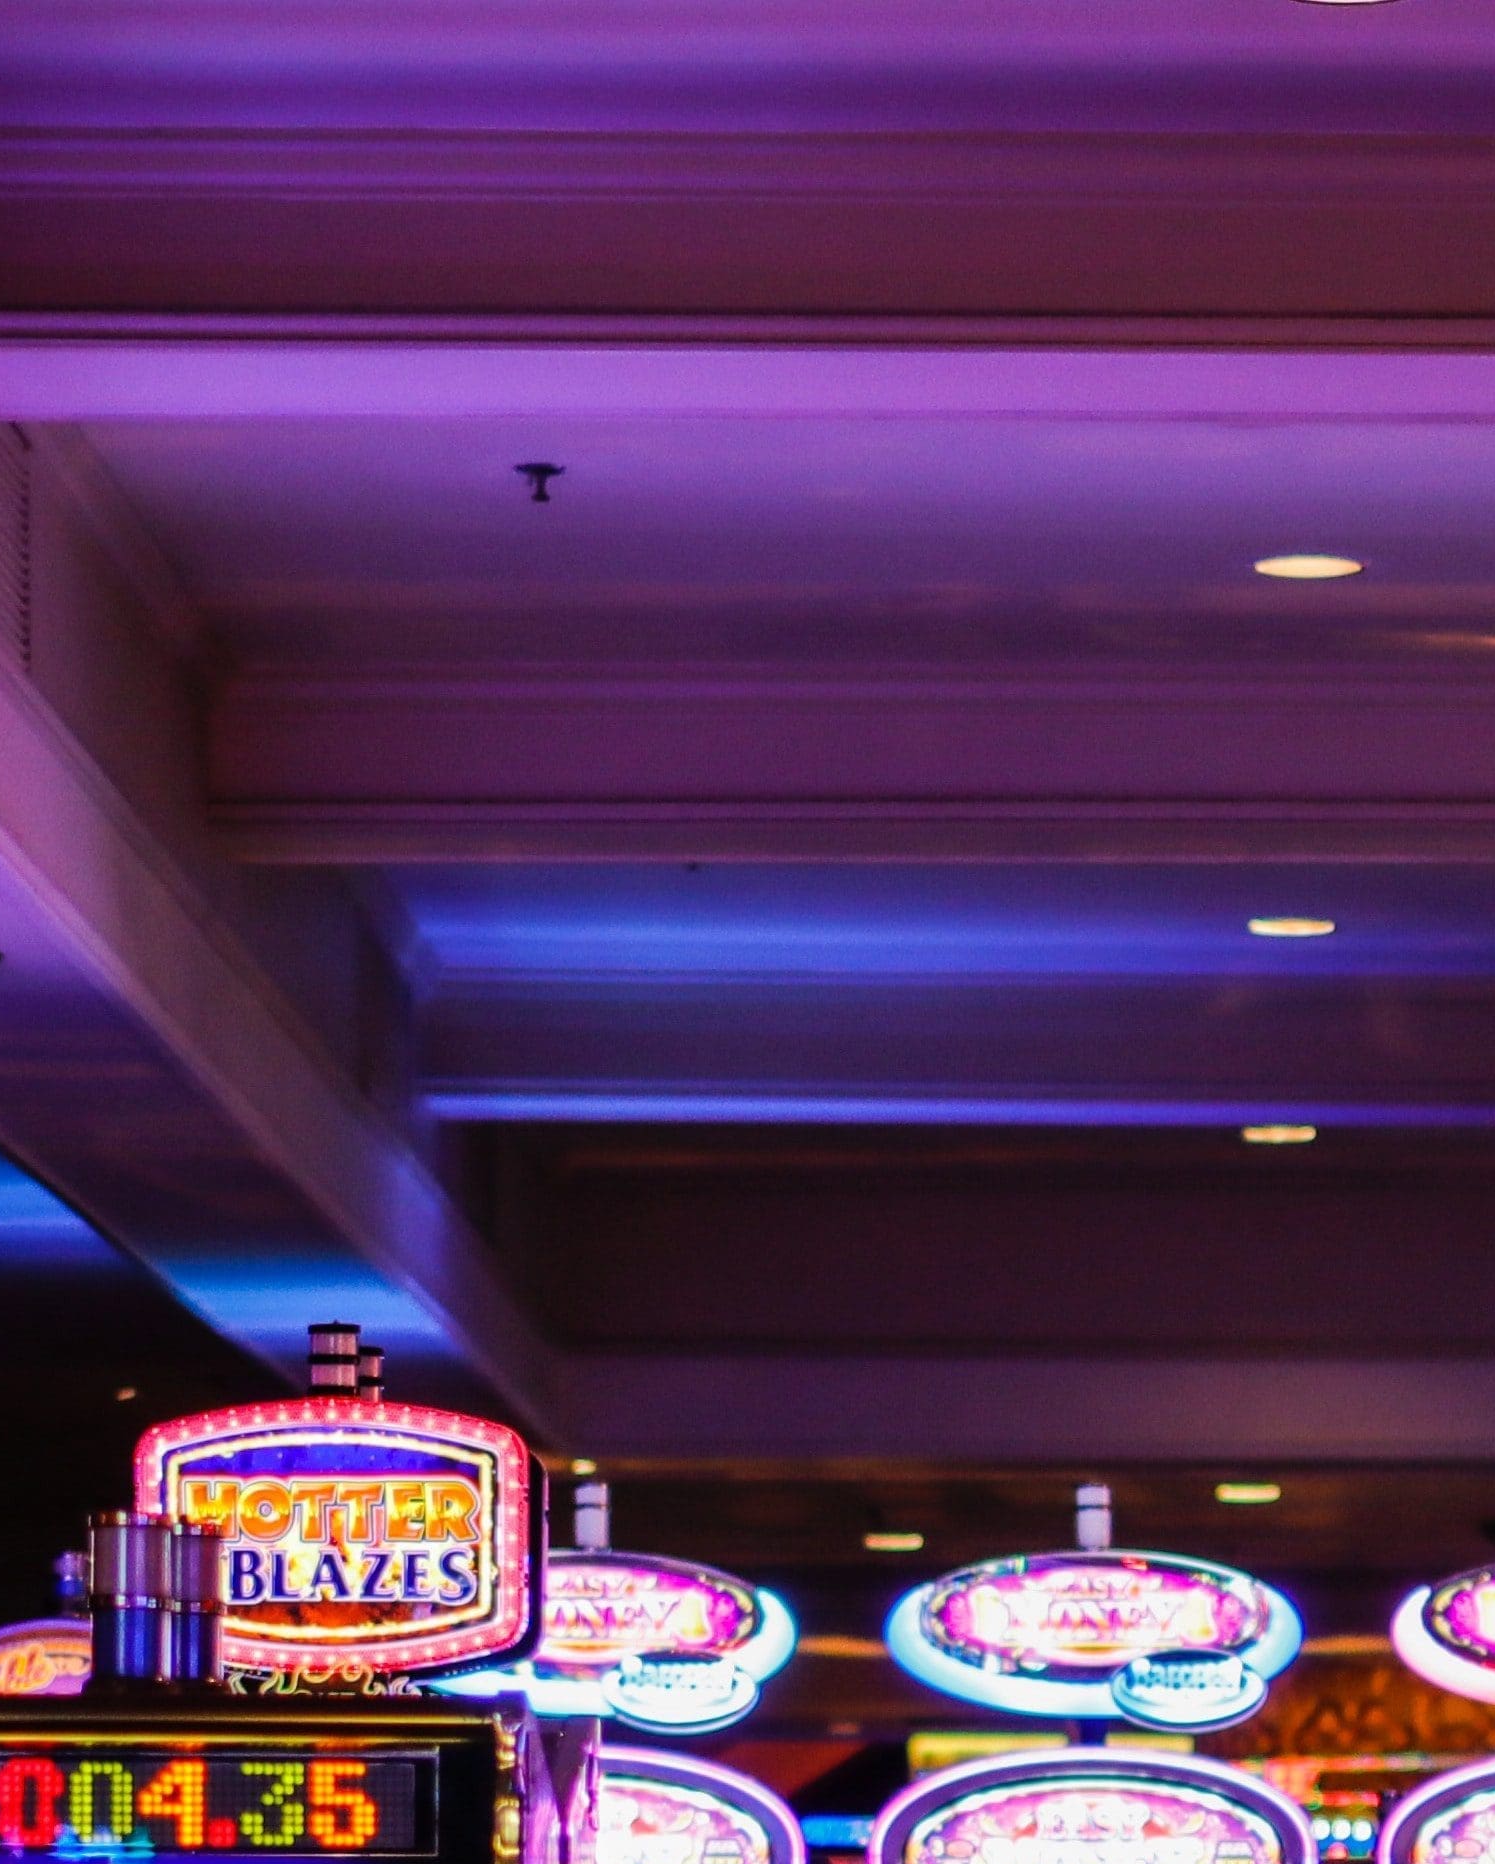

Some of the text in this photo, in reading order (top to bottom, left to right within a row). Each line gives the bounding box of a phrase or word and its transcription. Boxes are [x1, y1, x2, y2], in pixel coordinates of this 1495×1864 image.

[184, 1480, 480, 1544] HOTTER
[228, 1548, 476, 1605] BLAZES
[1003, 1600, 1182, 1642] MONEY
